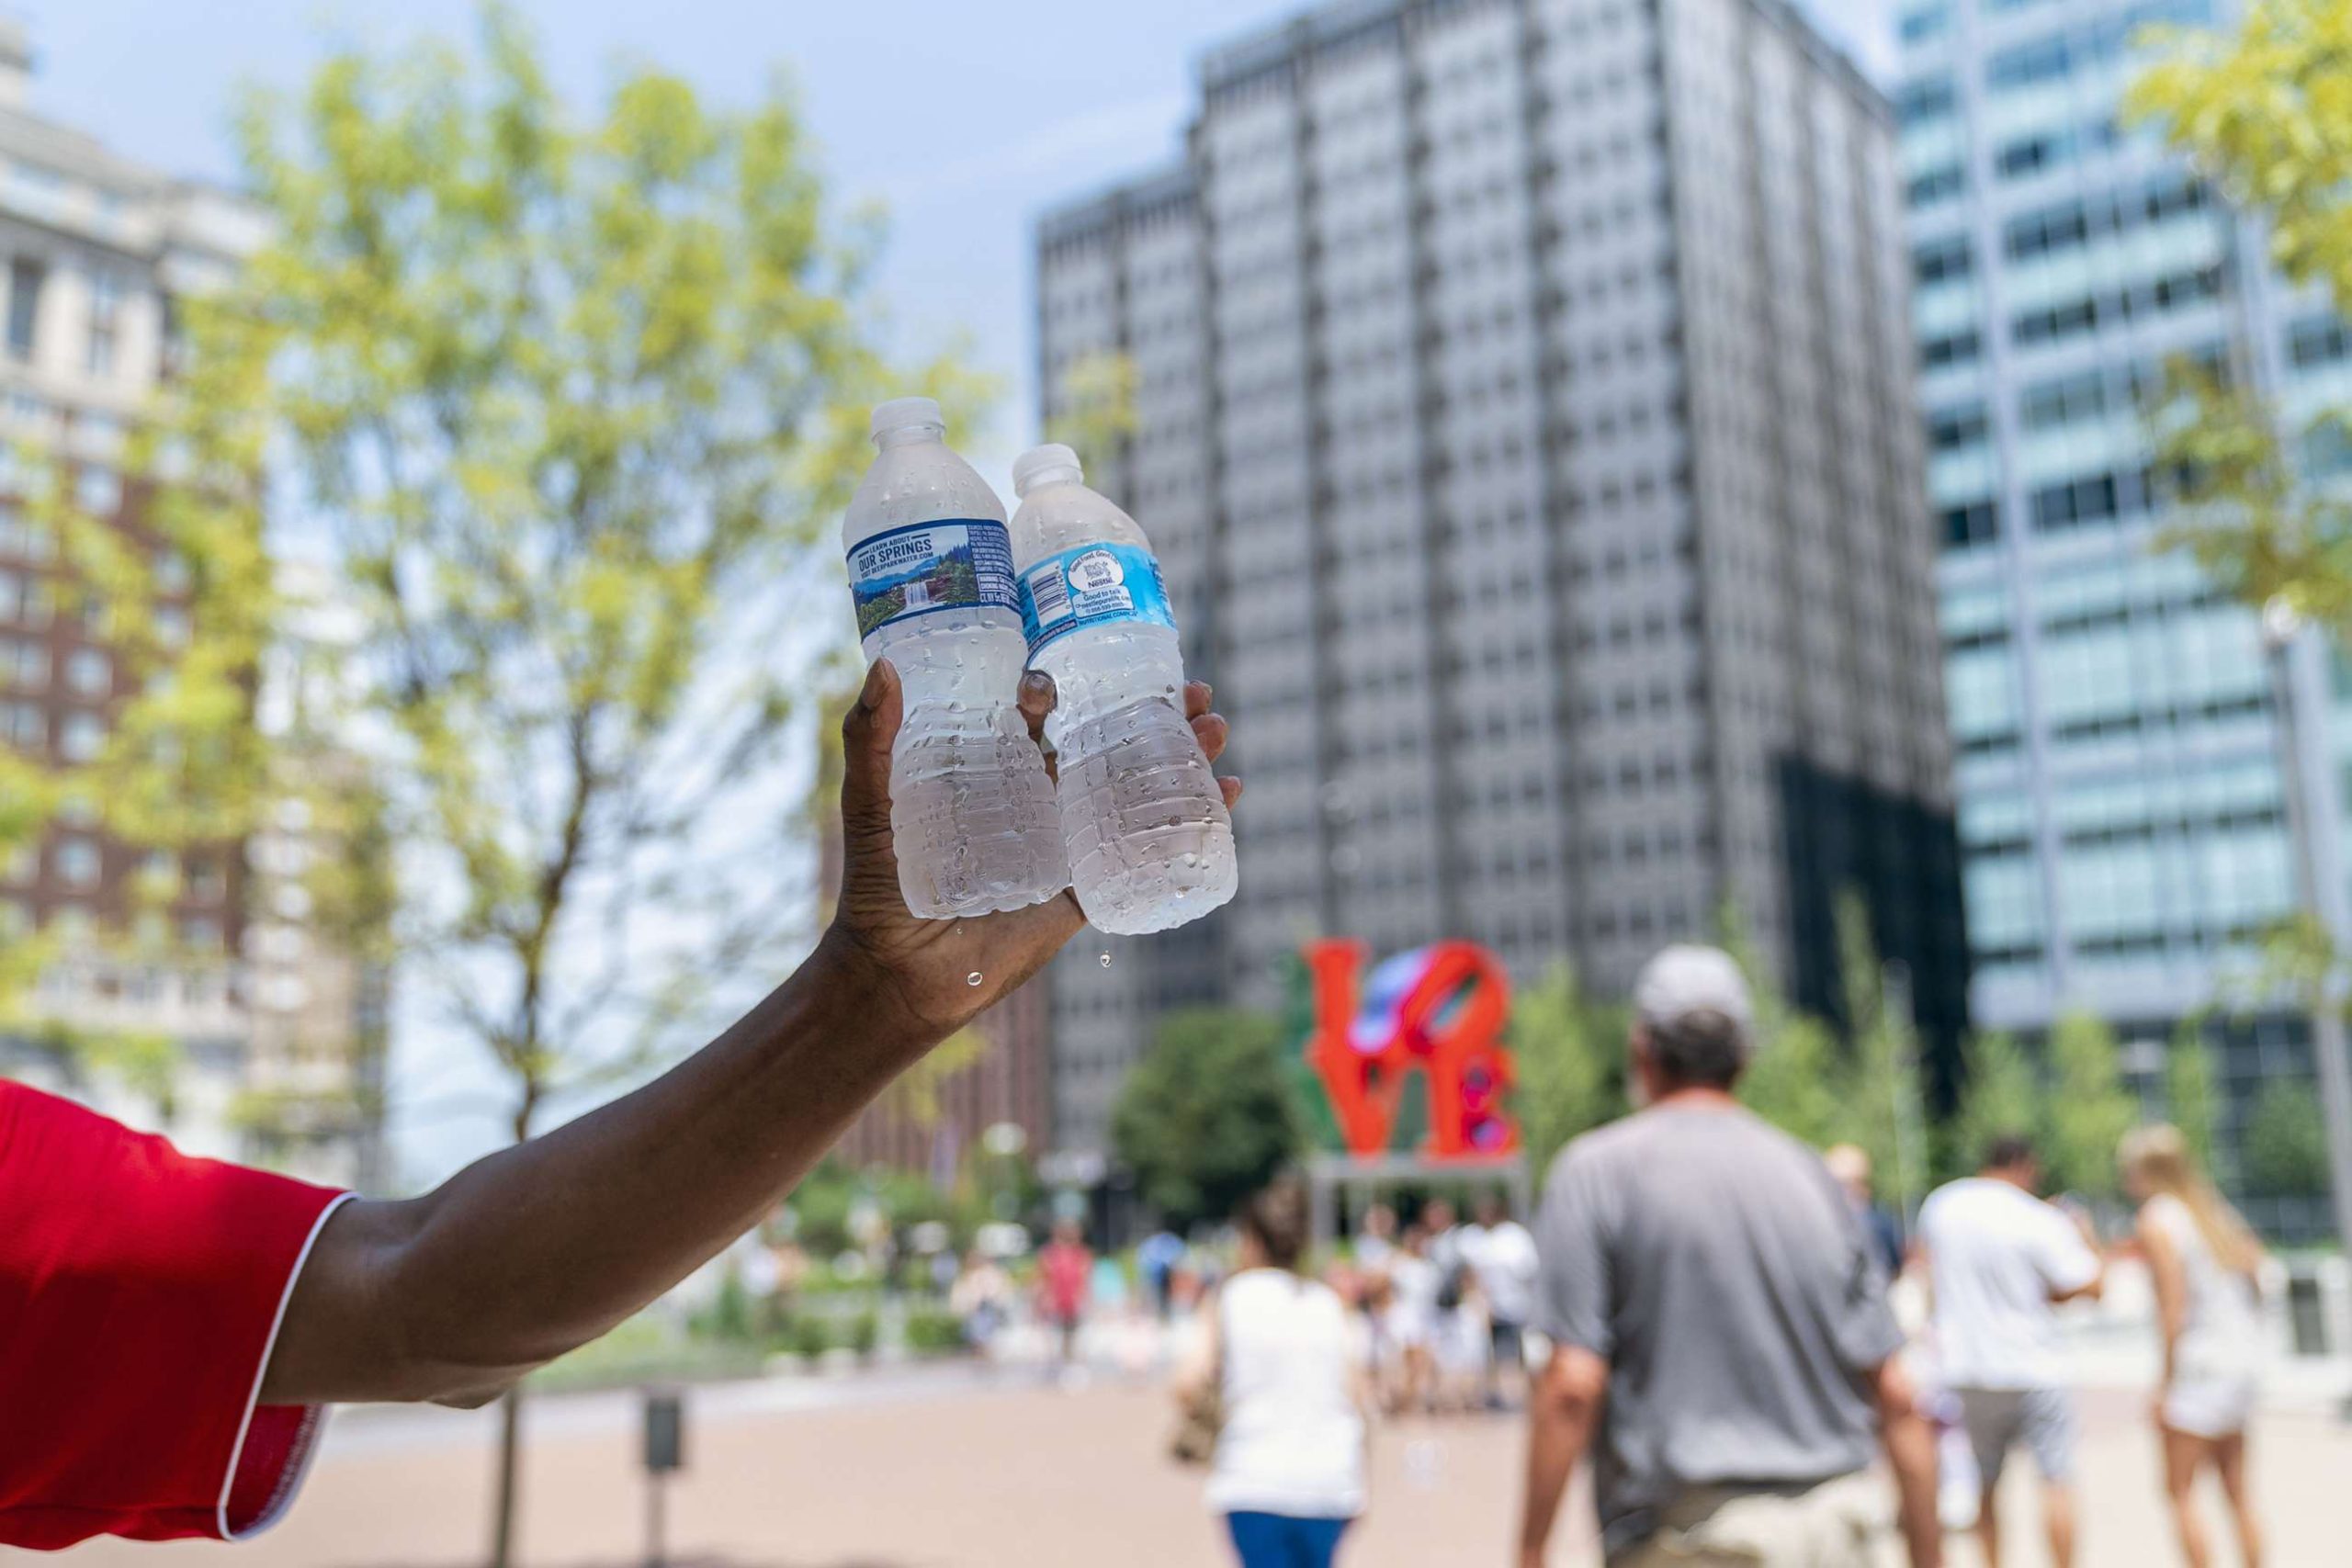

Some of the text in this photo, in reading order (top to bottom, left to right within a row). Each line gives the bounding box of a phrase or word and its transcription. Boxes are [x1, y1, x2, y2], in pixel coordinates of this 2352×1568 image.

[858, 538, 933, 572] OUR SPRINGS
[869, 536, 910, 554] LEARN ABOUT
[871, 551, 934, 574] DEERPARKWATER.COM
[1083, 591, 1101, 602] Good
